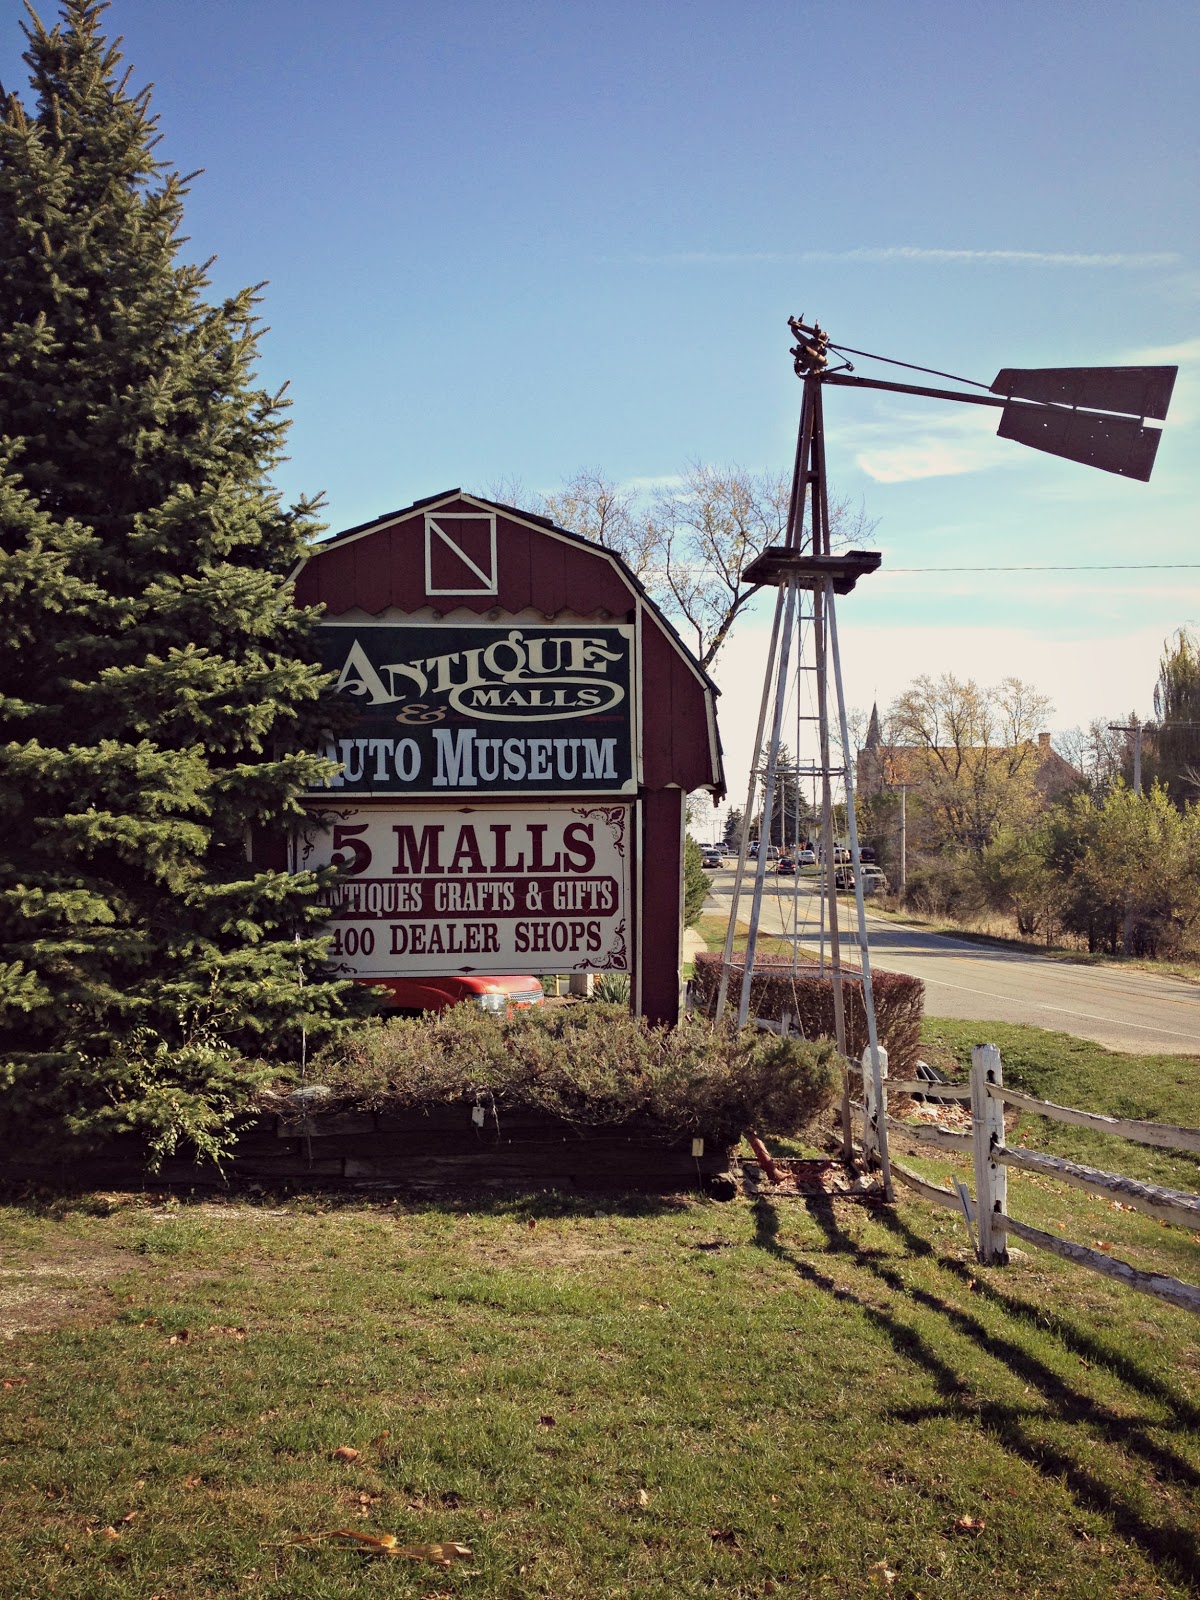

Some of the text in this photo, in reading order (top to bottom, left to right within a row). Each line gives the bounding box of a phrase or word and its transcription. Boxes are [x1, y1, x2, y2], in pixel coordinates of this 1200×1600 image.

[332, 630, 624, 706] ANTIQUE
[396, 704, 447, 725] &
[469, 689, 602, 707] MALLS
[308, 728, 618, 787] AUTO MUSEUM
[330, 822, 596, 875] 5 MALLS
[434, 881, 515, 912] CRAFTS
[525, 881, 544, 911] &
[553, 880, 613, 910] GIFTS
[328, 921, 602, 956] 400 DEALER SHOPS
